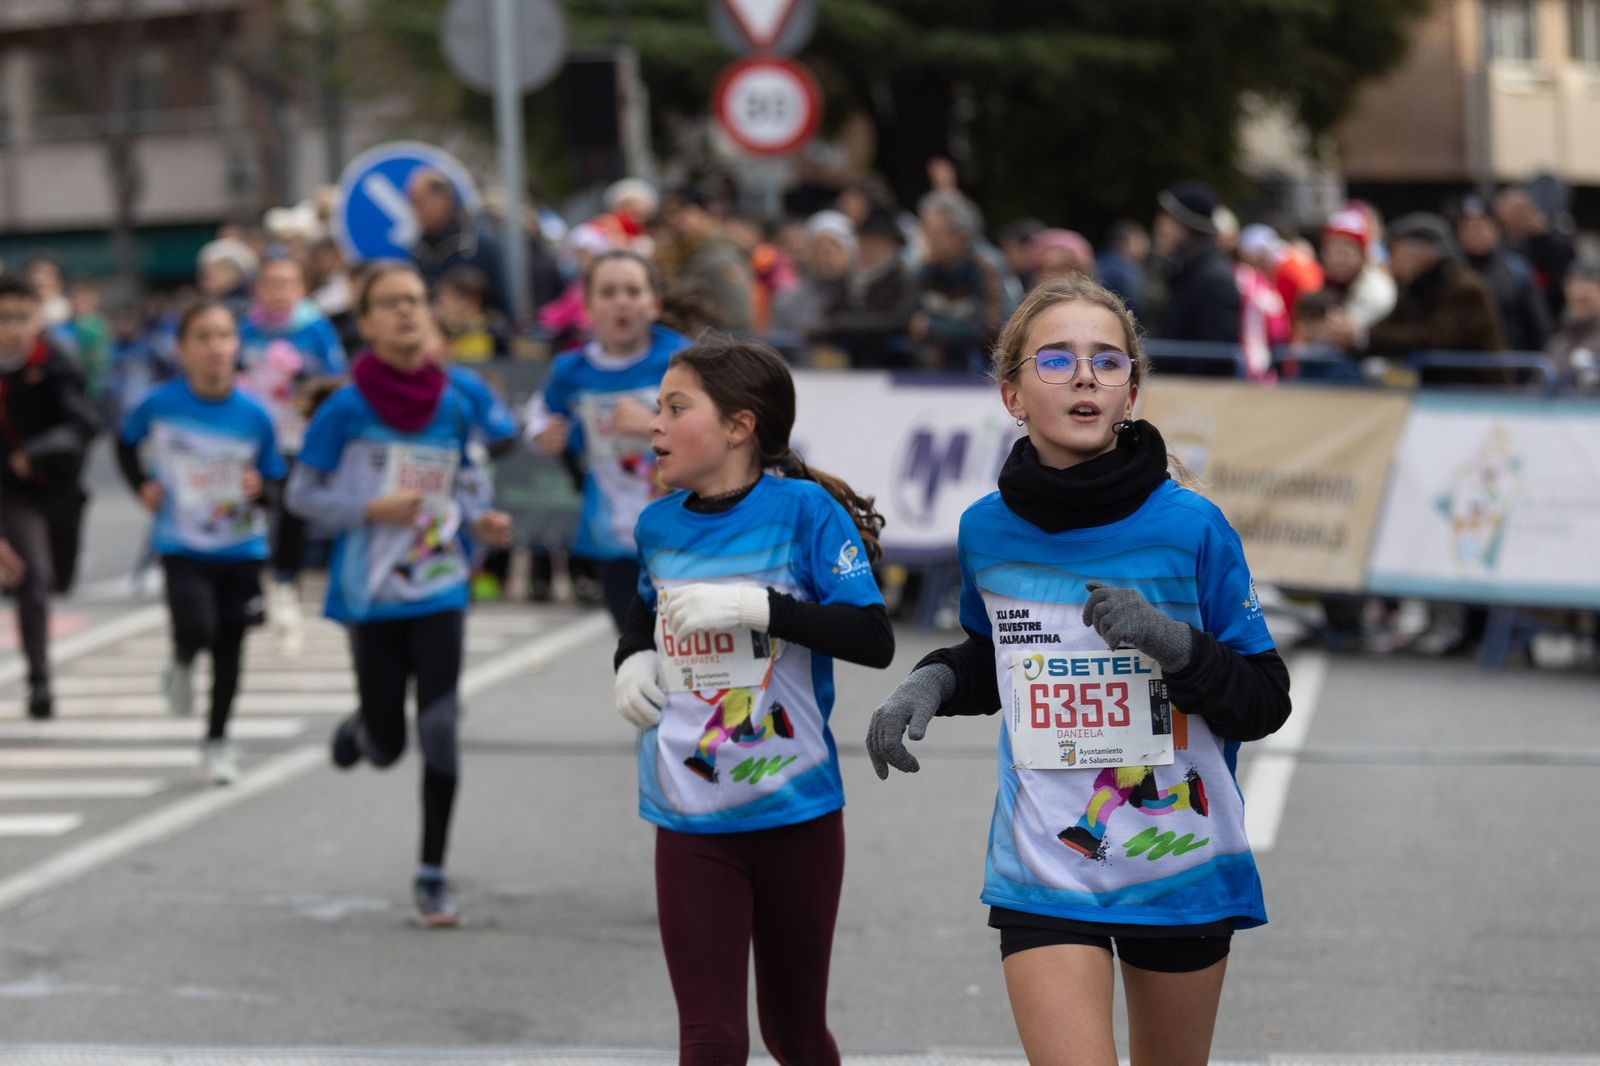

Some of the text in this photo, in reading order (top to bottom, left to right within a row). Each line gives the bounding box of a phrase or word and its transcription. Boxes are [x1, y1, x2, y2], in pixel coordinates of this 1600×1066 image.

[1008, 609, 1030, 619] SAN
[998, 622, 1042, 632] SILVESTRE
[999, 634, 1062, 645] SALMANTINA
[1047, 656, 1152, 677] SETEL
[1029, 682, 1131, 729] 6353
[1056, 728, 1104, 739] DANIELA
[1079, 747, 1123, 756] Ayuntamiento
[1079, 756, 1124, 765] de Salamanca
